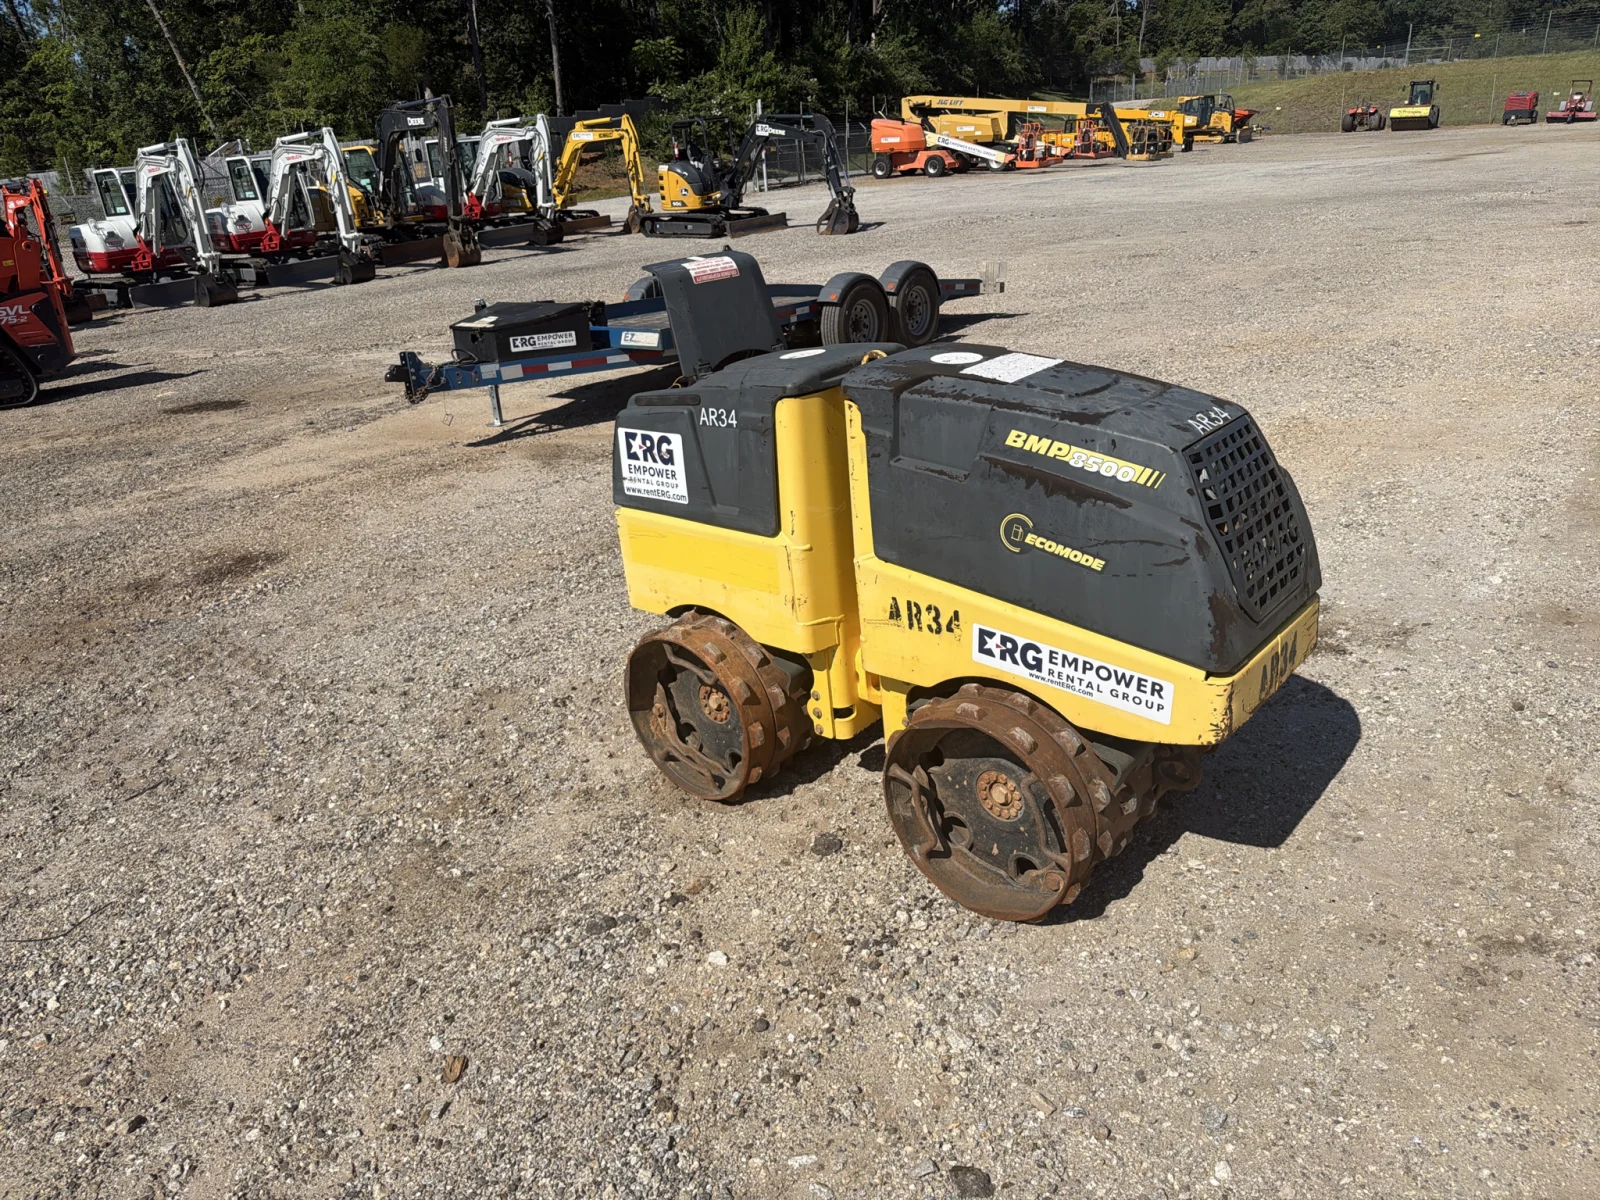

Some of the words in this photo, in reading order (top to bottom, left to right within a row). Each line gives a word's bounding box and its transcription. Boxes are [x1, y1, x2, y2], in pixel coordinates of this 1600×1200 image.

[407, 117, 425, 126] DEERE
[937, 137, 949, 145] ERG
[512, 337, 537, 349] ERG
[537, 332, 573, 341] EMPOWER
[699, 407, 738, 428] AR34
[1187, 405, 1232, 435] AR34
[624, 431, 675, 466] ERG
[628, 463, 677, 480] EMPOWER
[628, 476, 654, 486] RENTAL
[656, 480, 679, 489] GROUP
[626, 486, 688, 502] www.rentERG.com
[1024, 532, 1106, 572] ECOMODE
[888, 596, 963, 642] AR34
[978, 627, 1043, 674] ERG
[1029, 671, 1094, 698] www.rentERG.com
[1048, 650, 1165, 700] EMPOWER
[1048, 668, 1104, 694] RENTAL
[1109, 687, 1166, 713] GROUP
